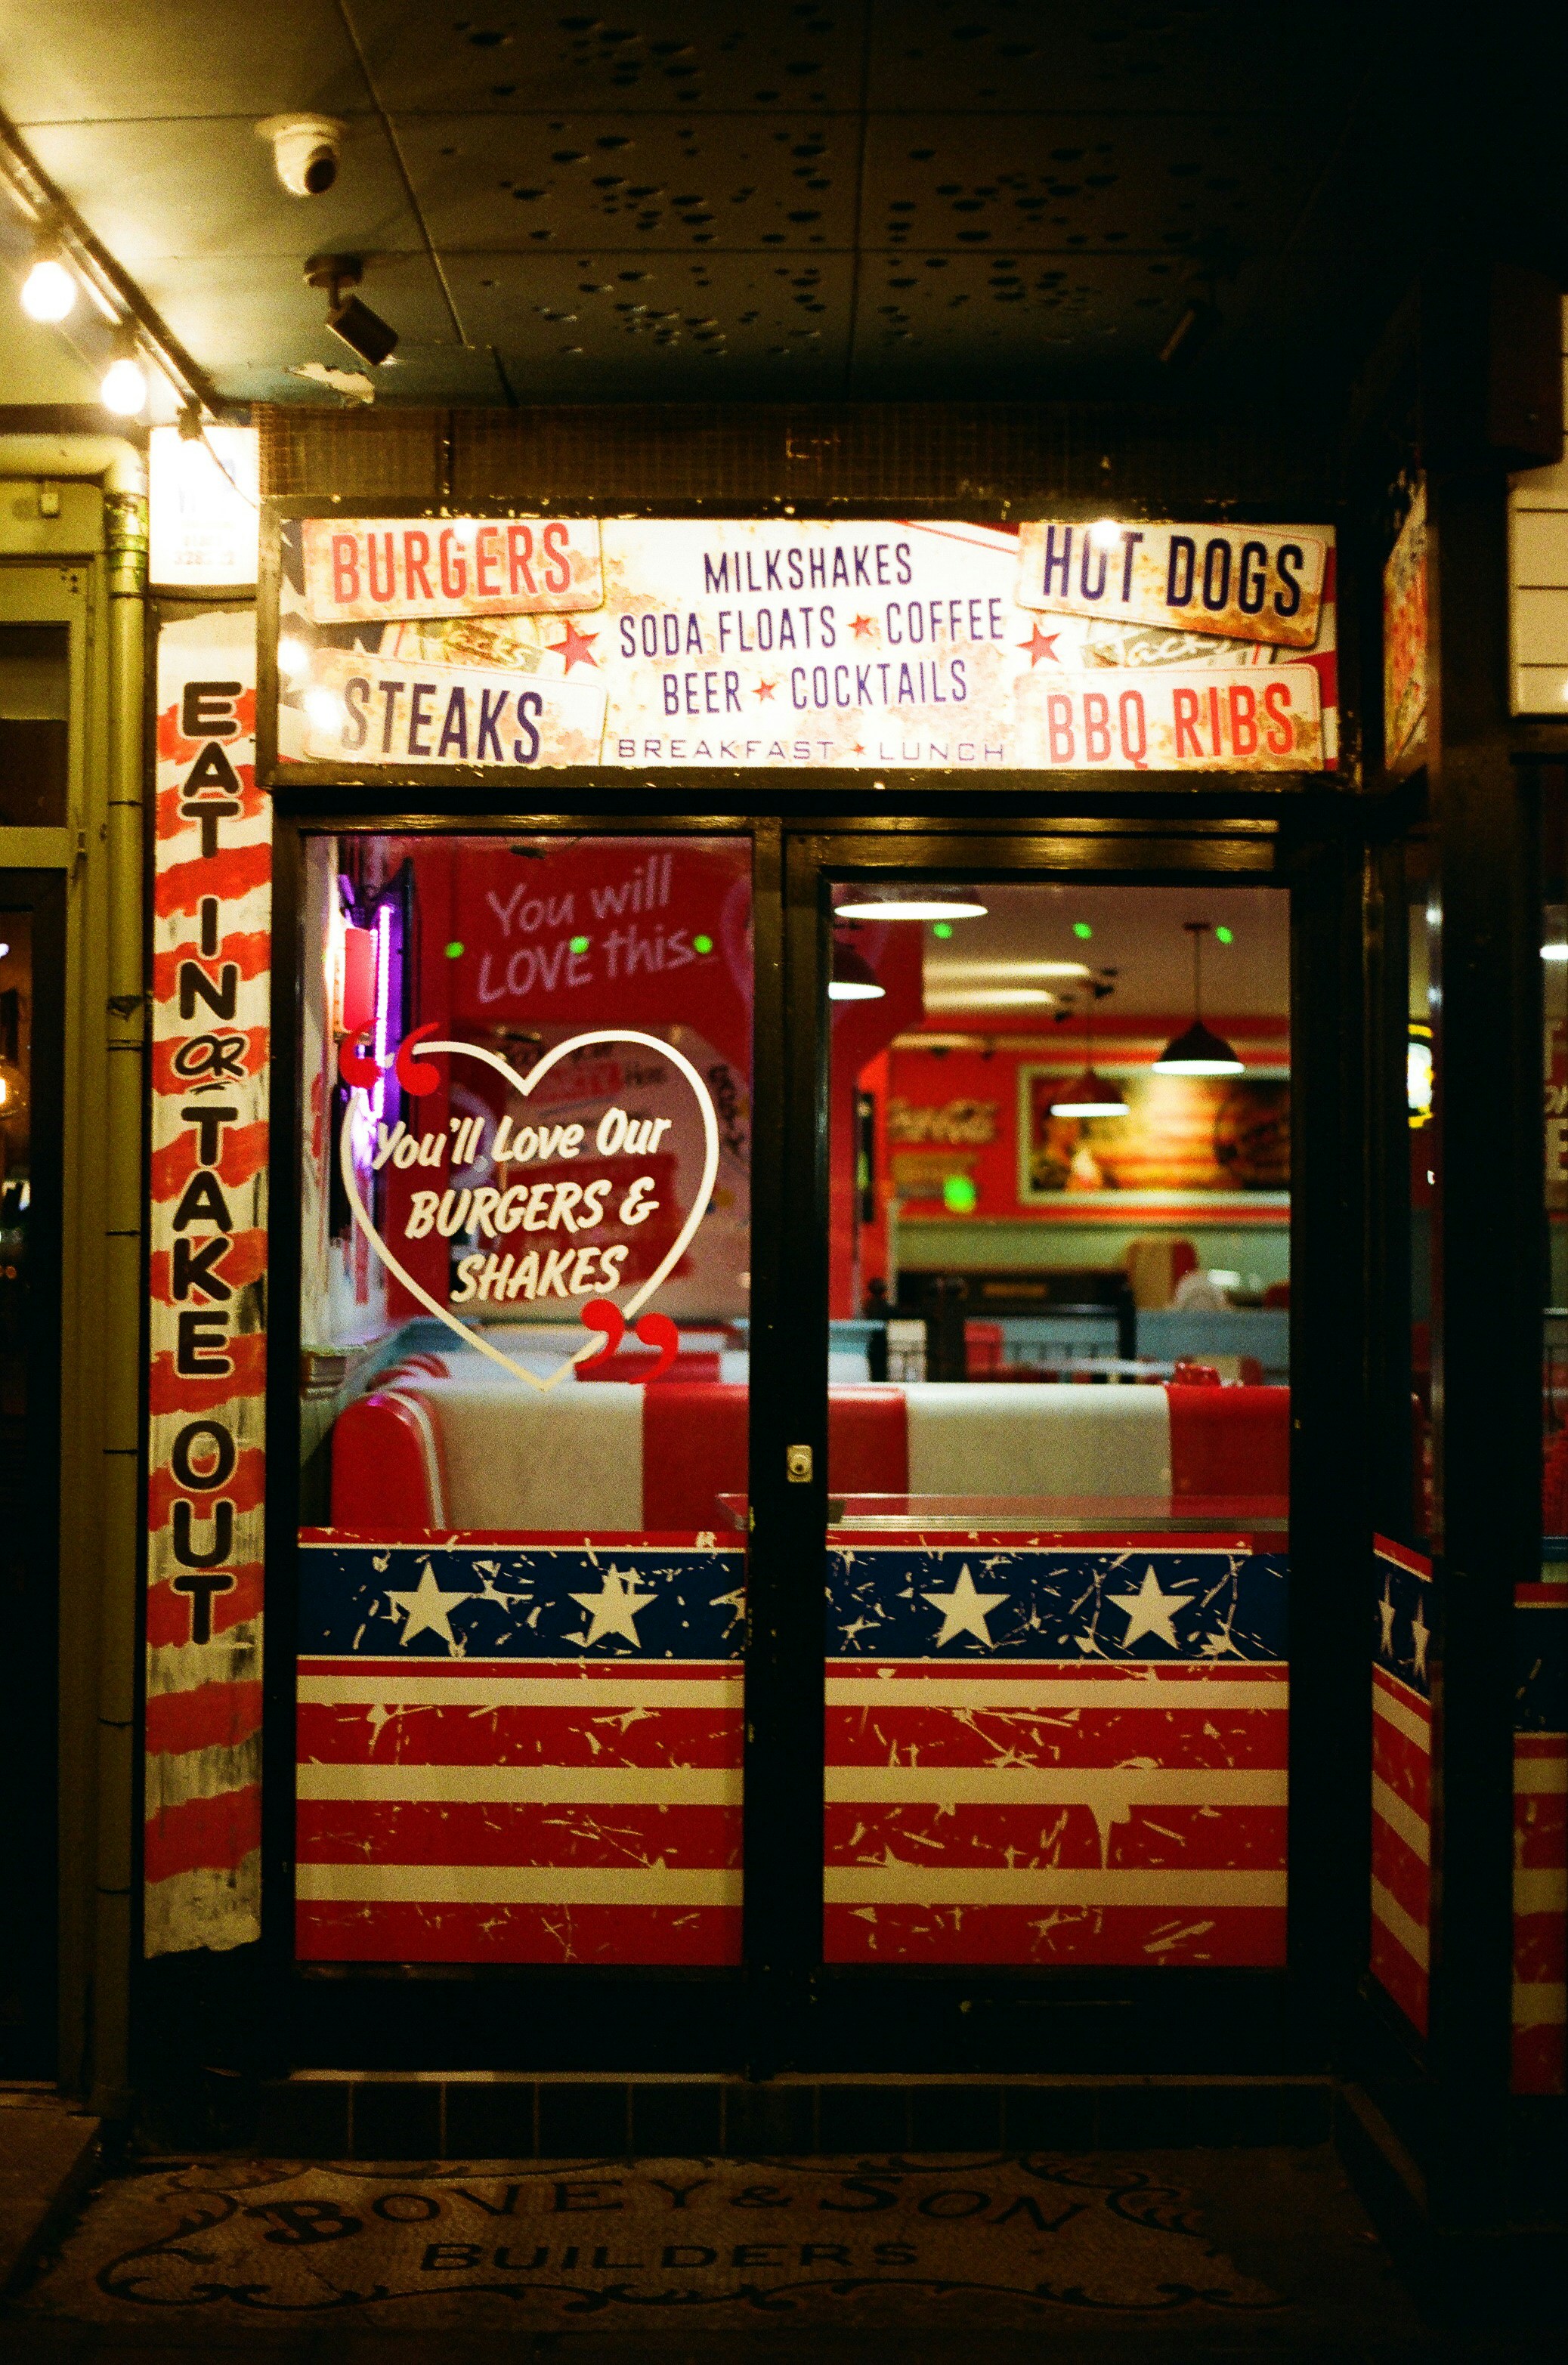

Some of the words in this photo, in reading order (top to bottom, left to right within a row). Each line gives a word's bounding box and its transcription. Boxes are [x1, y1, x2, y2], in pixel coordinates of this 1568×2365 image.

[332, 522, 571, 604] BURGERS
[704, 543, 912, 593] MILKSHAKES
[1042, 524, 1144, 602] HOT
[1167, 535, 1304, 617] DOGS
[620, 613, 703, 658] SODA
[719, 605, 837, 654] FLOATS
[886, 598, 1004, 645] COFFEE
[340, 677, 543, 765] STEAKS
[663, 671, 744, 716] BEER
[791, 659, 967, 710] COCKTAILS
[1047, 689, 1149, 768] BBQ
[1173, 682, 1294, 758] RIBS
[181, 681, 243, 858] EAT
[618, 739, 833, 760] BREAKFAST
[880, 743, 1004, 762] LUNCH
[485, 883, 574, 937] You
[590, 854, 673, 920] will
[179, 897, 239, 1020] IN
[478, 935, 593, 1003] LOVE
[602, 923, 696, 979] this
[175, 1034, 246, 1077] OR
[372, 1116, 486, 1170] You'll
[490, 1114, 582, 1164] Love
[596, 1108, 672, 1156] Our
[172, 1107, 238, 1375] TAKE
[404, 1179, 612, 1240] BURGERS
[618, 1176, 660, 1227] &
[450, 1244, 629, 1303] SHAKES
[172, 1420, 237, 1644] OUT
[251, 2178, 709, 2246] BOVEY
[727, 2184, 793, 2211] &
[820, 2175, 1089, 2233] SON
[422, 2243, 919, 2271] BUILDERS
